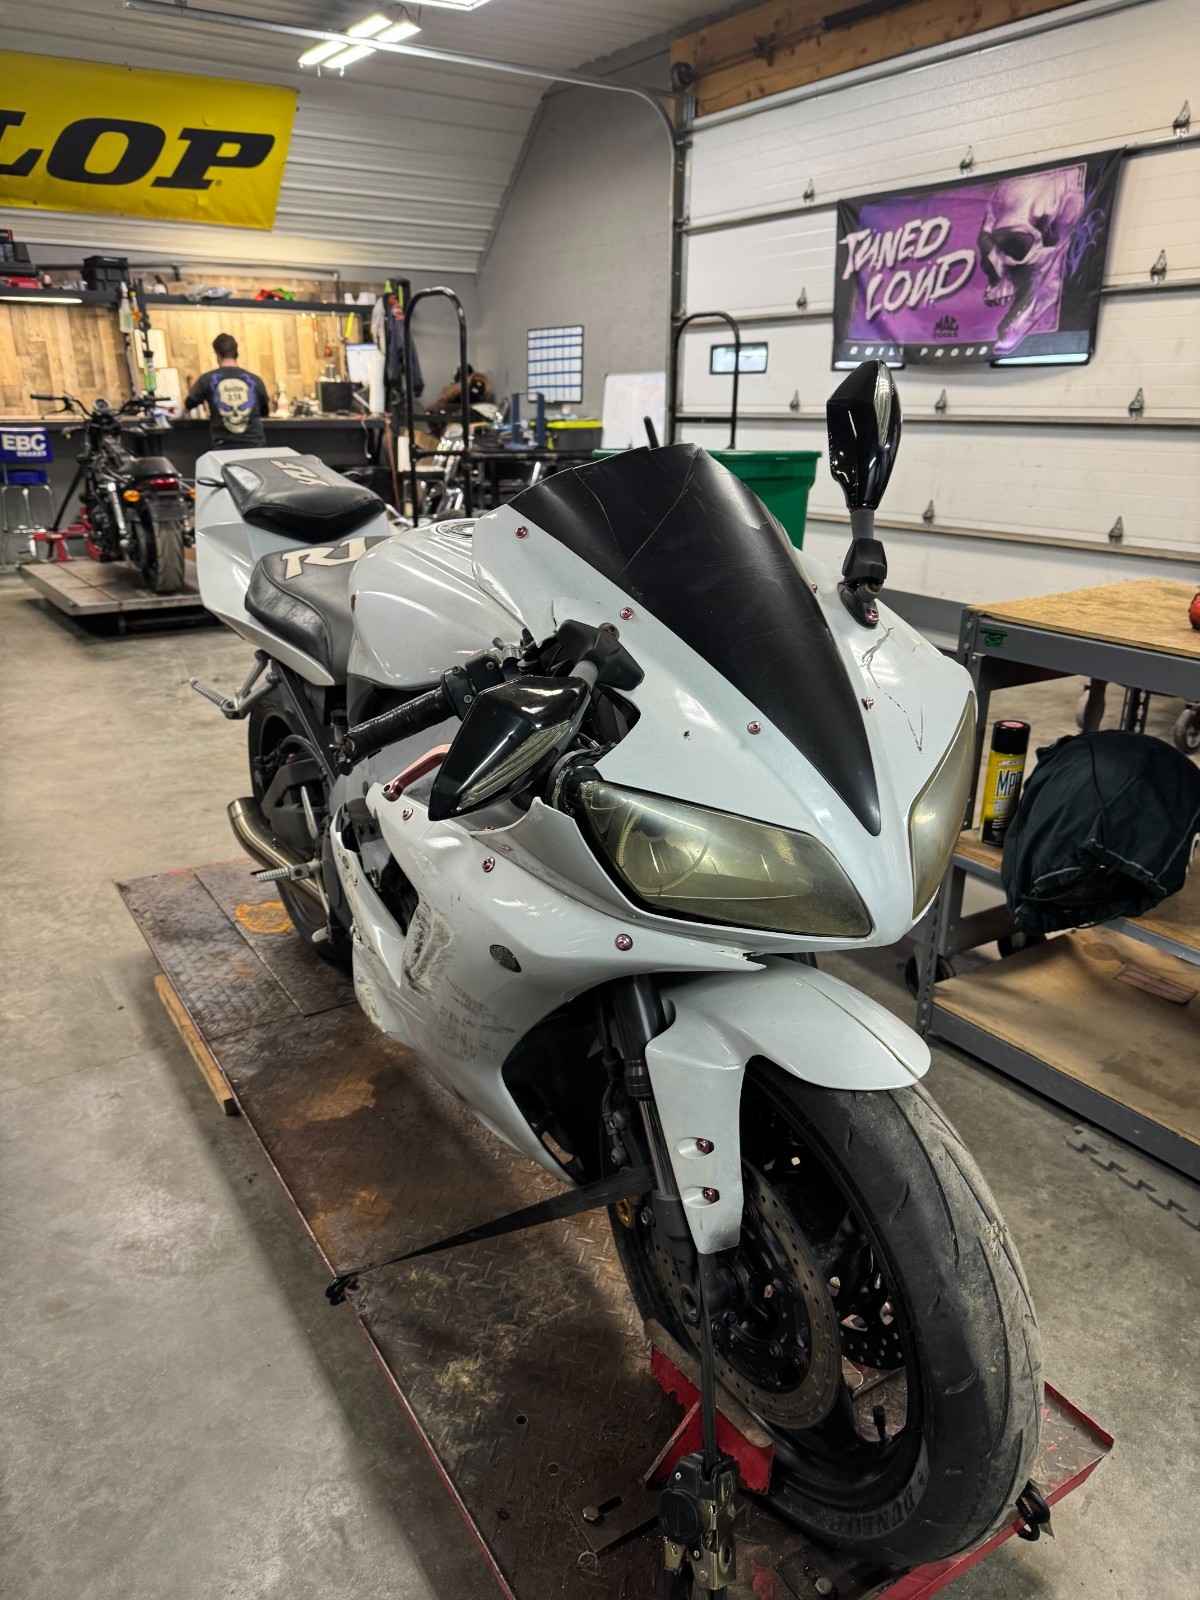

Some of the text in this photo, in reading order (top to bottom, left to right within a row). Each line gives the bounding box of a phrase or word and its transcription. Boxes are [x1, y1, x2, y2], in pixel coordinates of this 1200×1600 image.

[838, 216, 951, 280] TUNED
[865, 249, 976, 320] LOUD
[934, 315, 959, 331] MAC
[919, 345, 989, 357] PROUD
[1, 434, 46, 451] EBC
[281, 536, 367, 580] R1
